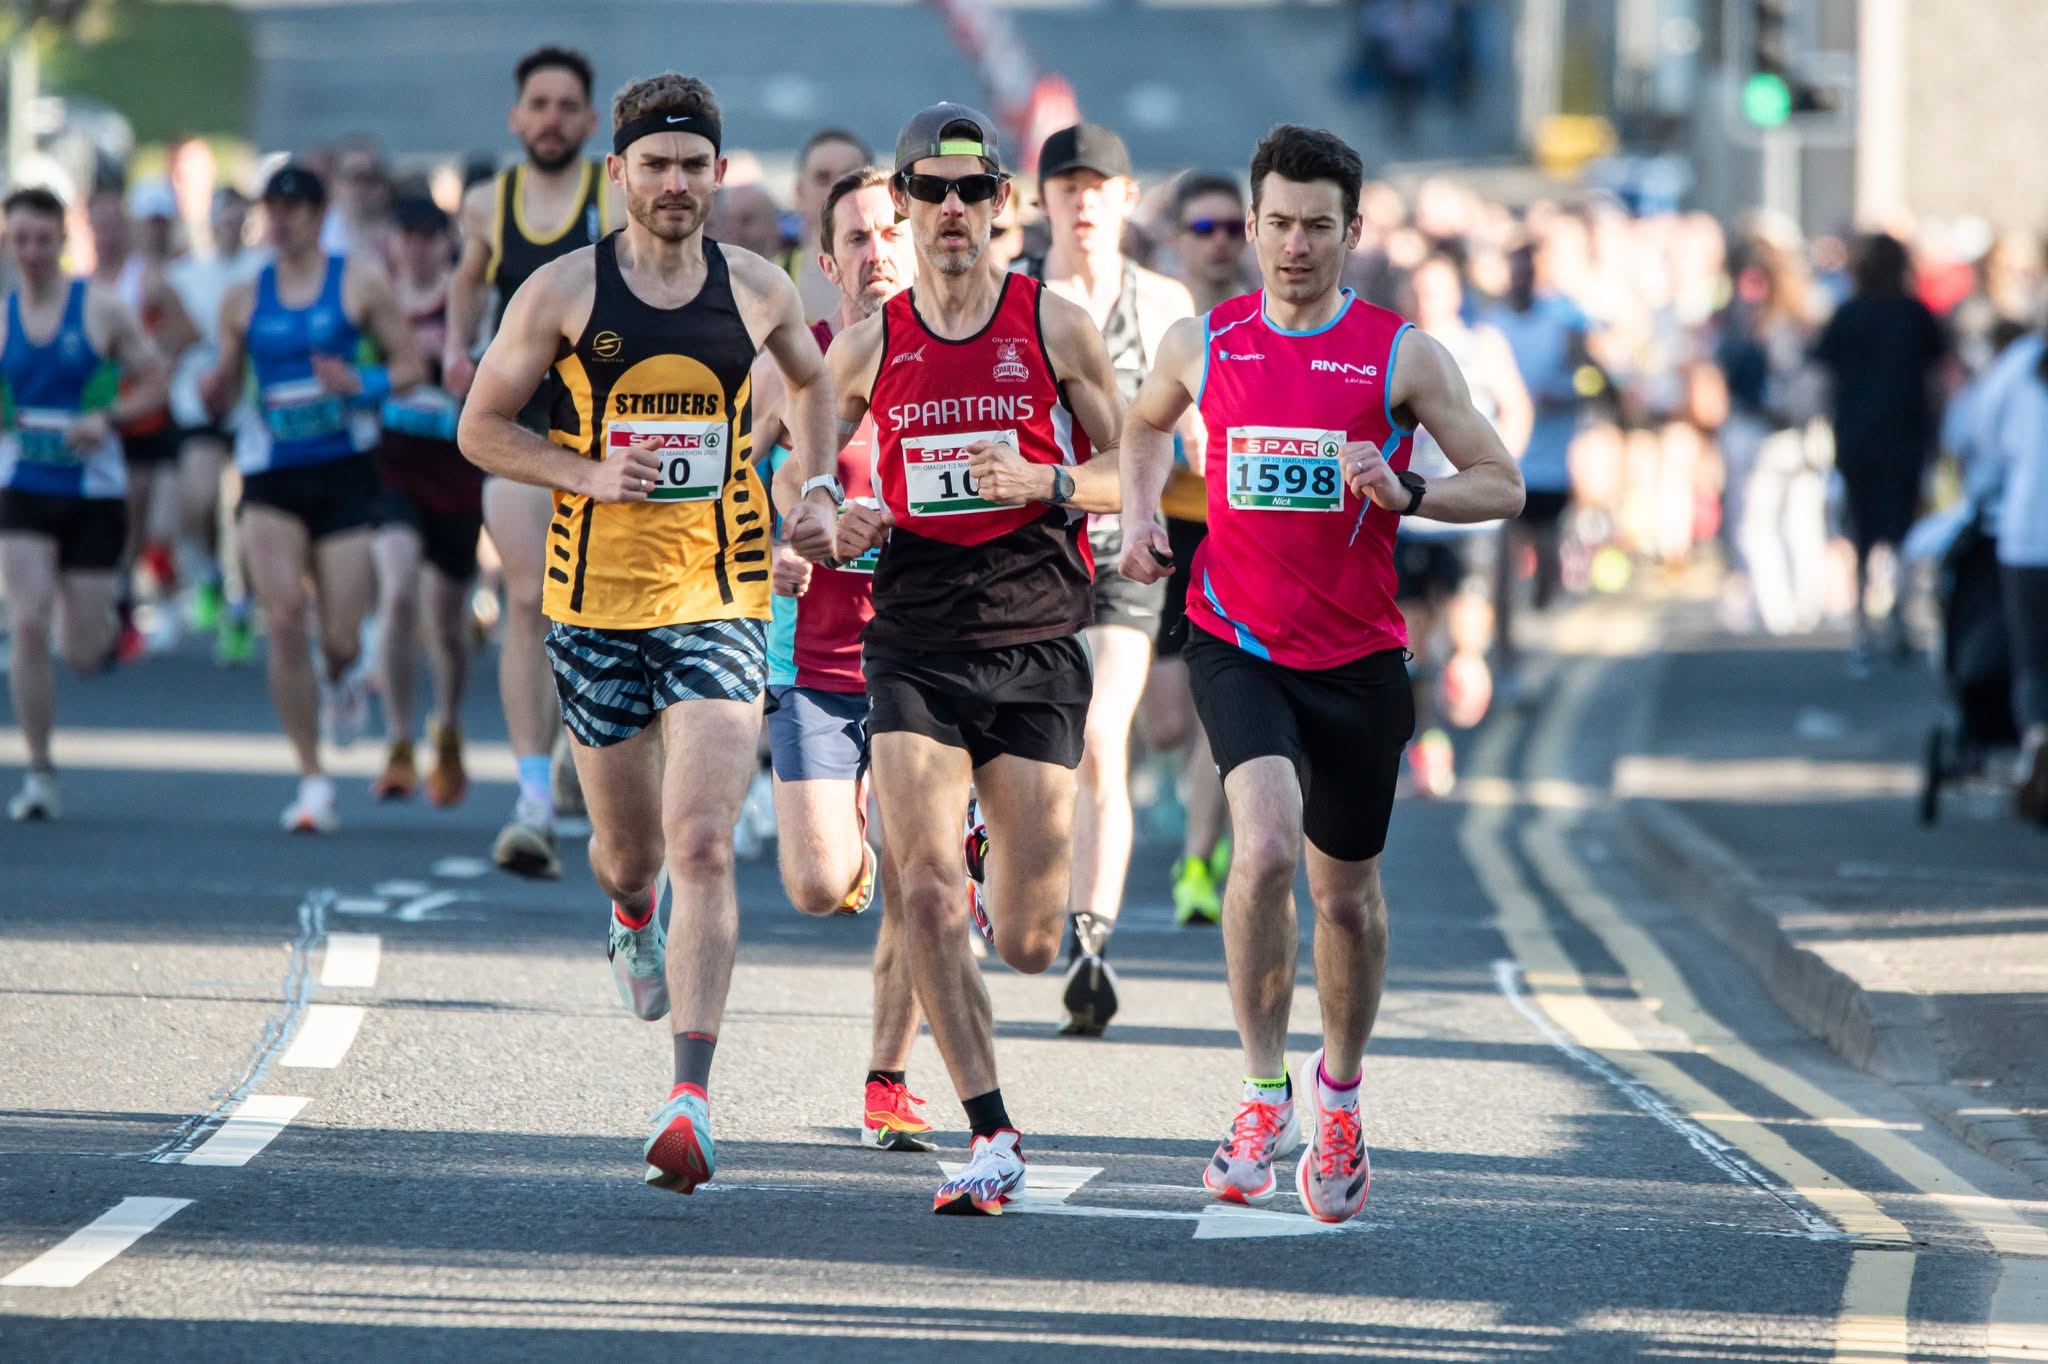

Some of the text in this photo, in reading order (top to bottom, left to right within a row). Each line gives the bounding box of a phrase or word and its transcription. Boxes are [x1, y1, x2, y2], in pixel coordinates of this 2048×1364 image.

[993, 365, 1028, 378] SPARTANS
[615, 393, 719, 415] STRIDERS
[888, 395, 1034, 431] SPARTANS
[1247, 440, 1318, 456] SPAR
[1282, 457, 1320, 466] MARATHON
[1236, 463, 1336, 495] 1598
[1272, 497, 1292, 505] Nick
